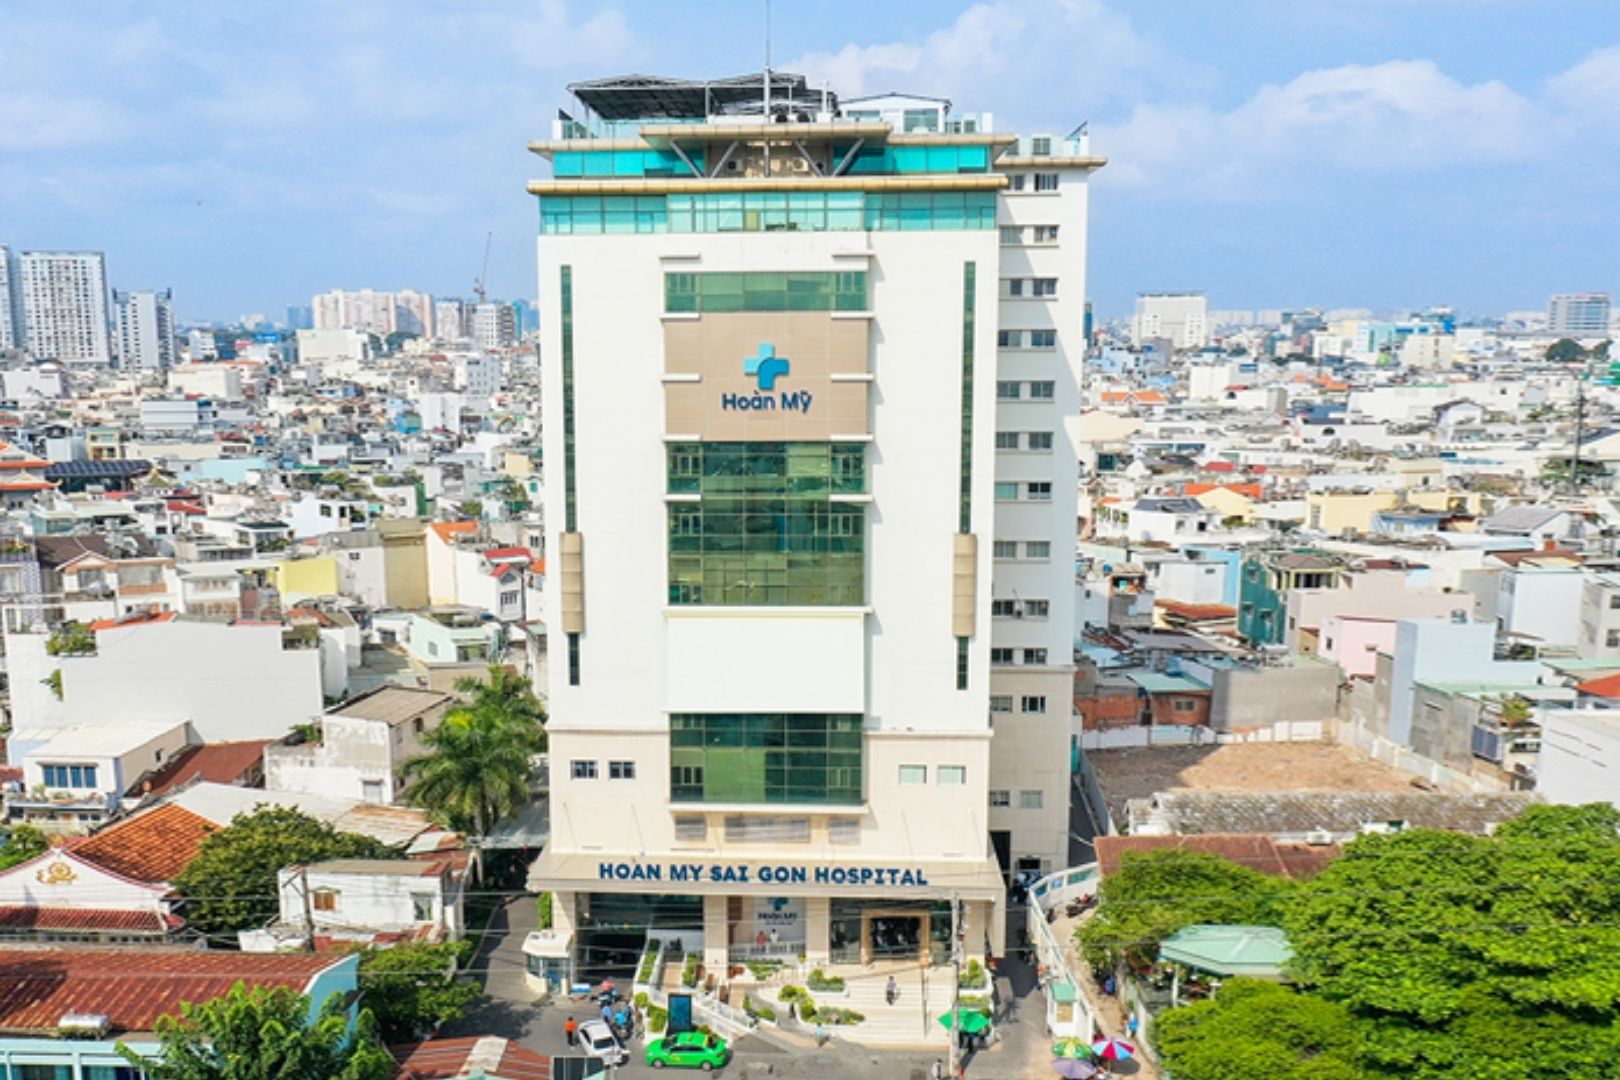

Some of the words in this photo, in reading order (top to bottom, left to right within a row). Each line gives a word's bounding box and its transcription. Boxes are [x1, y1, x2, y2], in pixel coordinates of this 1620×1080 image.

[722, 389, 775, 411] Hoàn
[781, 389, 813, 414] Mỹ
[599, 862, 661, 880] HOAN
[670, 864, 703, 881] MY
[710, 866, 748, 882] SAI
[758, 866, 806, 883] GON
[814, 867, 928, 886] HOSPITAL
